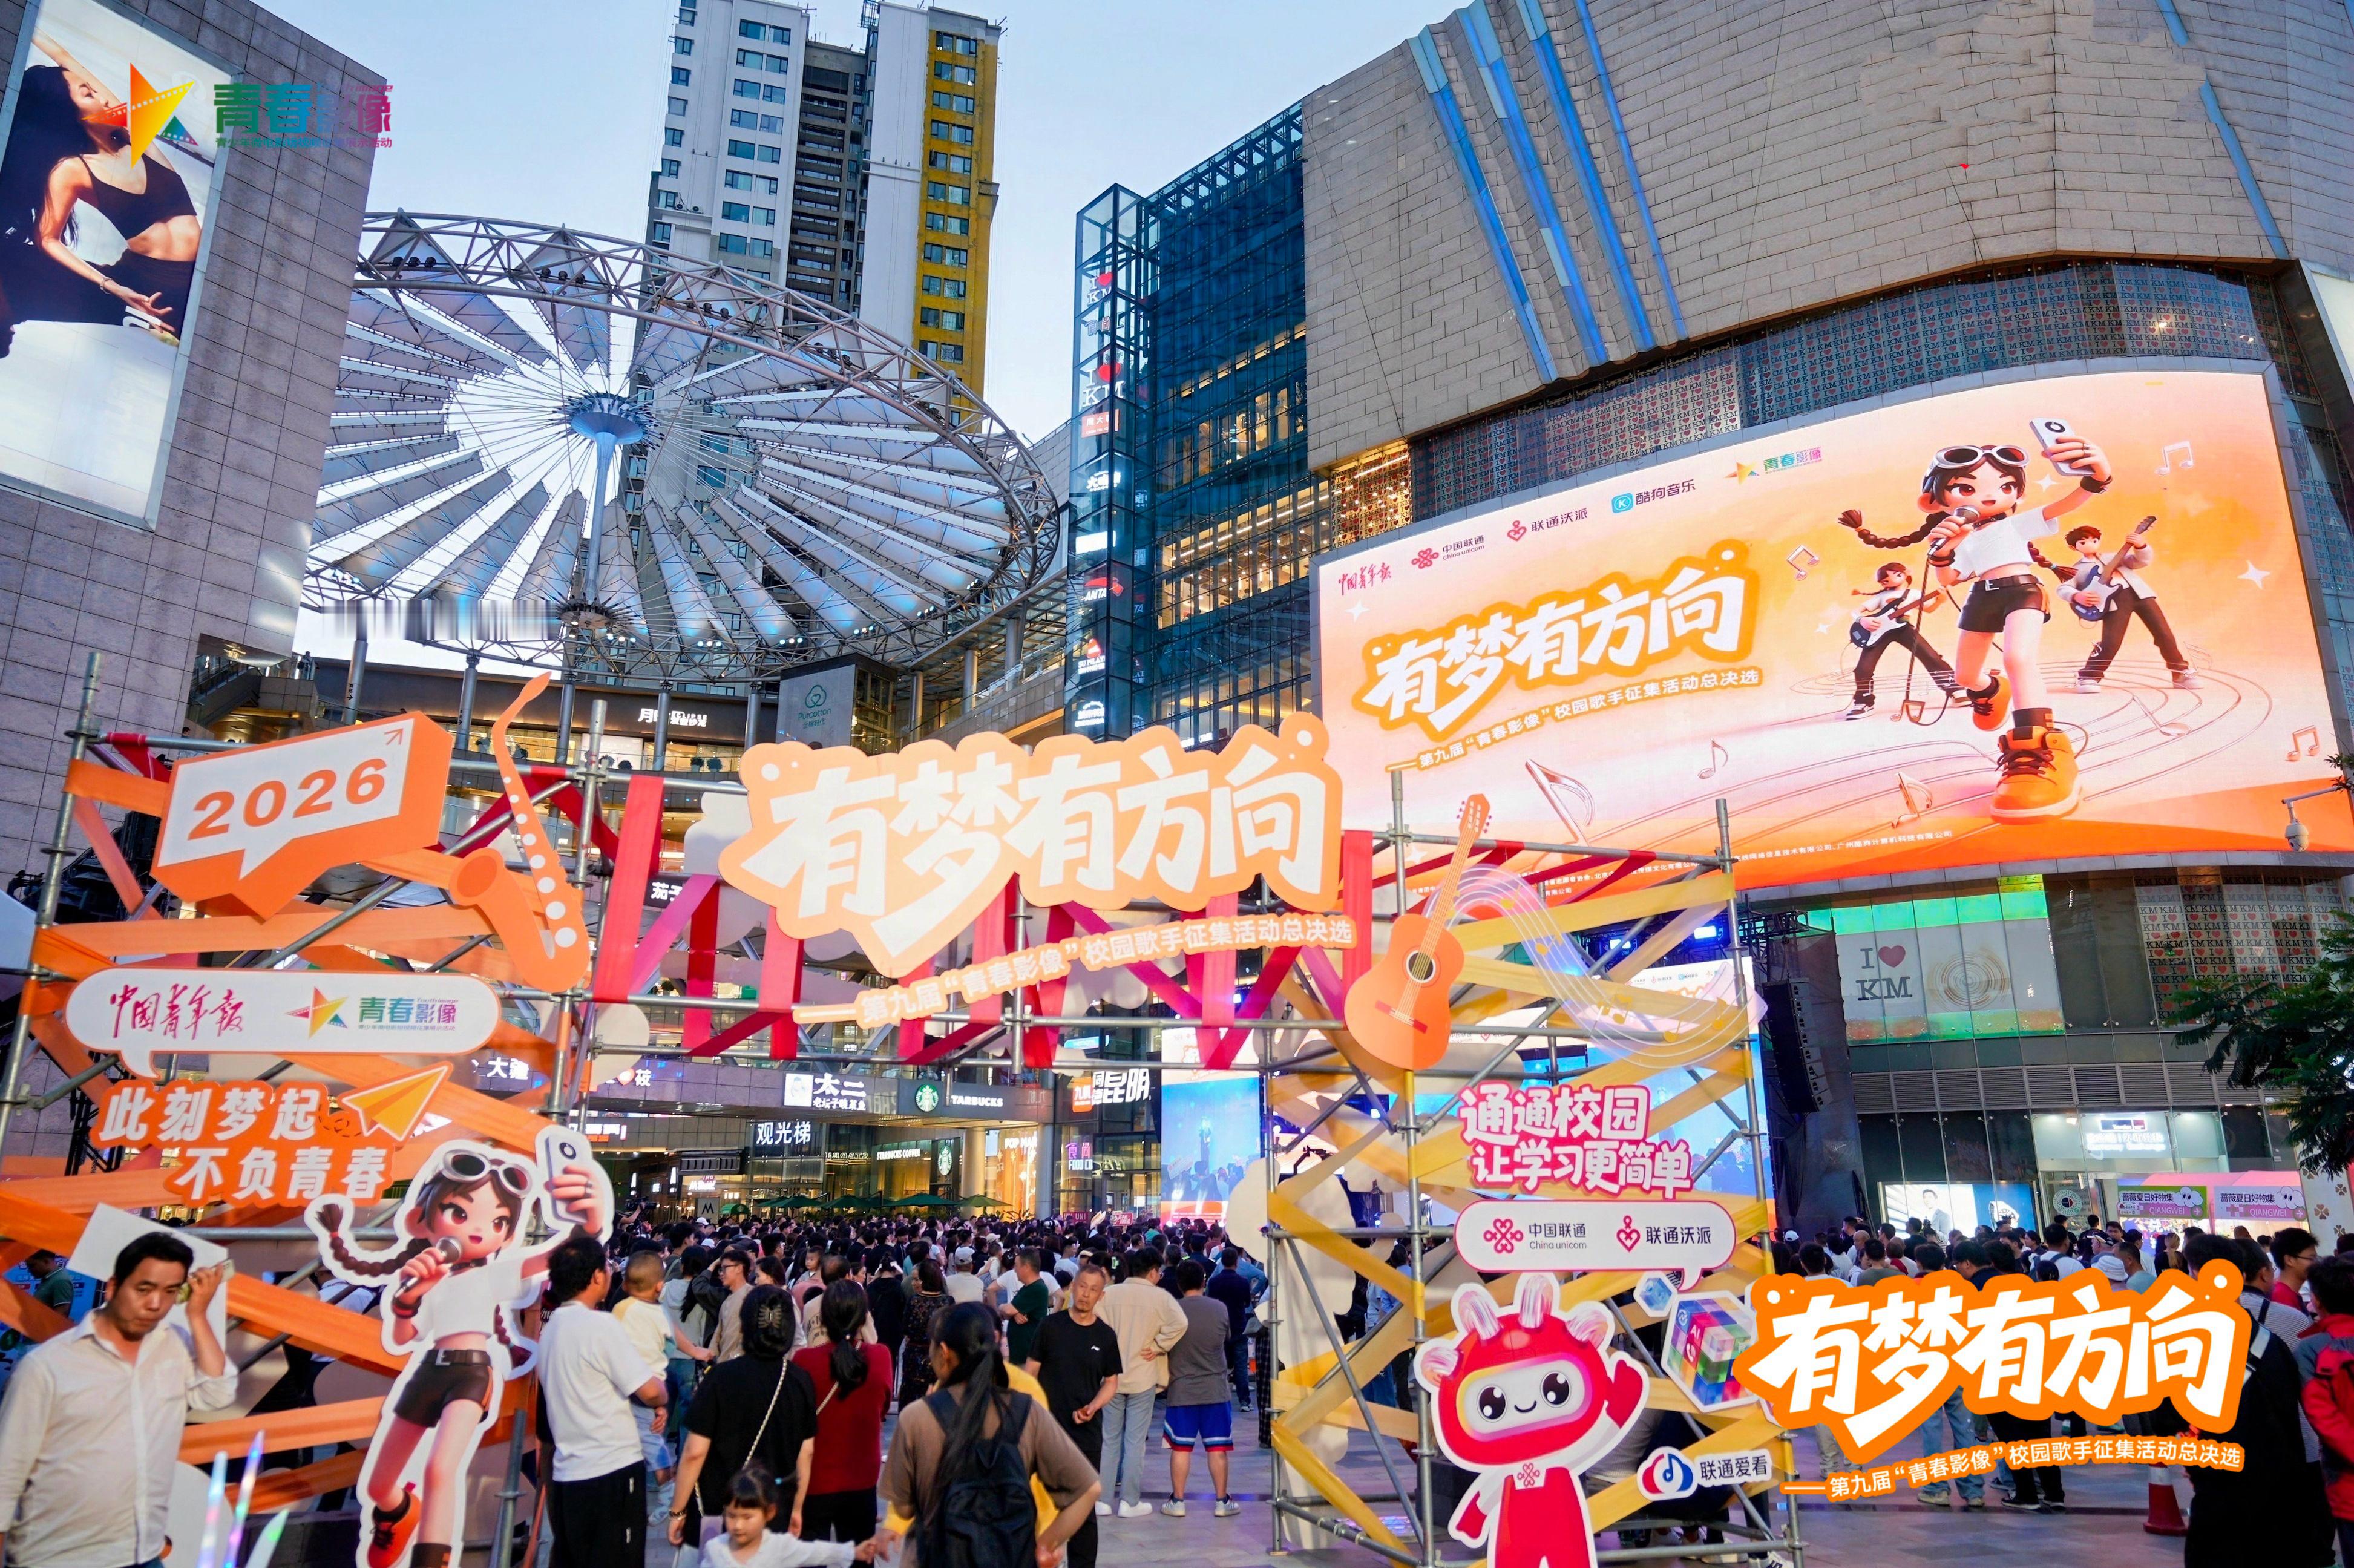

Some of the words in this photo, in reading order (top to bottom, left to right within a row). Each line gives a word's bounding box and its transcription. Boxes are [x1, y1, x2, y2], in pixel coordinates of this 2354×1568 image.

[1901, 306, 1915, 315] KM
[1907, 346, 1921, 355] KM
[1706, 389, 1719, 398] KM
[1636, 479, 1696, 505] 酷狗音乐
[1531, 508, 1588, 532] 联通沃派
[1442, 535, 1484, 554] 中国联通
[1443, 550, 1461, 560] China
[1461, 544, 1485, 556] unicom
[1339, 562, 1391, 595] 中国青年报
[1084, 587, 1107, 601] ANTA
[1363, 567, 1744, 732] 有梦有方向
[798, 709, 831, 720] Purcotton
[188, 758, 387, 841] 2026
[741, 743, 1325, 957] 有梦有方向
[1860, 948, 1875, 969] I
[1856, 976, 1913, 1000] KM
[110, 983, 243, 1040] 中国青年报
[358, 997, 457, 1024] 青春影像
[813, 1073, 867, 1097] 太二
[950, 1095, 1003, 1107] TARBUCKS
[99, 1086, 320, 1142] 此刻梦起
[1461, 1084, 1647, 1144] 通通校园
[756, 1121, 811, 1145] 观光梯
[877, 1149, 902, 1160] STARBUCKS
[902, 1148, 920, 1158] COFFEE
[175, 1146, 388, 1202] 不负青春
[1069, 1160, 1083, 1170] FOOD
[1472, 1140, 1692, 1199] 让学习更简单
[2221, 1193, 2275, 1203] 蔷薇夏日好物集
[2149, 1207, 2185, 1215] QIANGWEI
[2249, 1208, 2287, 1217] QIANGWEI
[1529, 1222, 1587, 1238] 中国联通
[1646, 1225, 1711, 1245] 联通沃派
[1529, 1240, 1555, 1250] China
[1556, 1241, 1587, 1250] unicom
[1690, 1324, 1700, 1340] AI
[1700, 1455, 1768, 1482] 联通爱看
